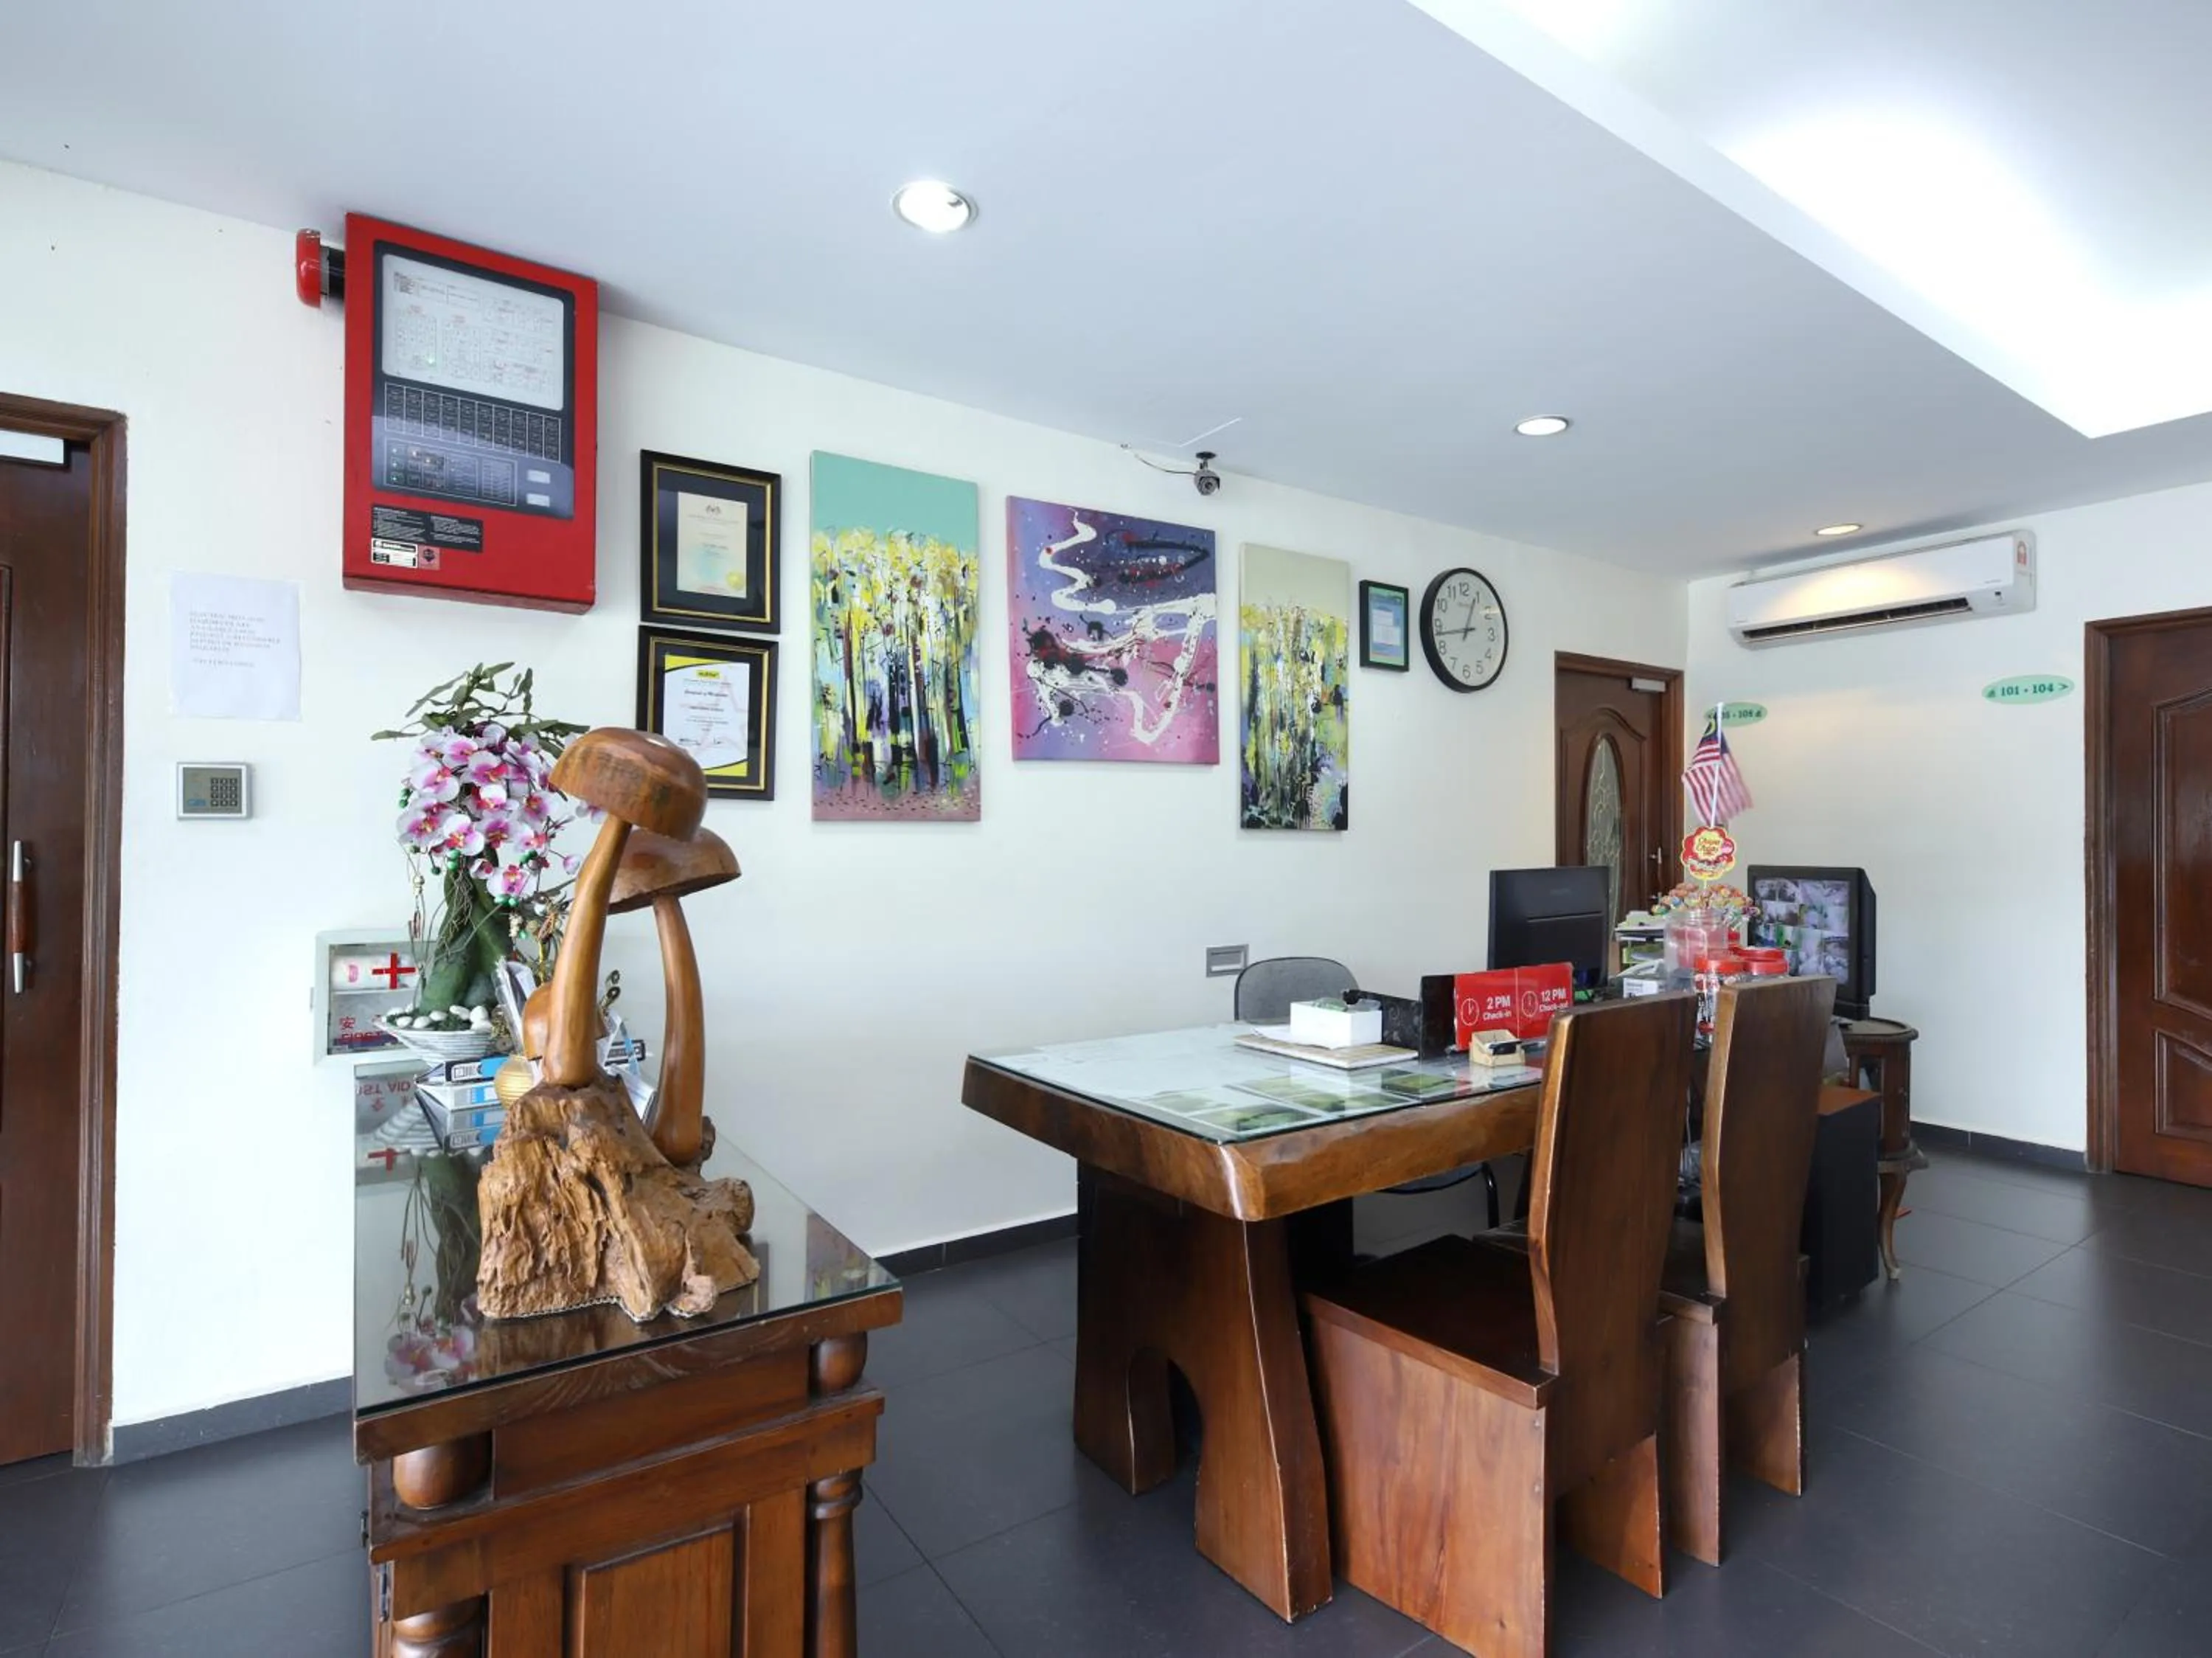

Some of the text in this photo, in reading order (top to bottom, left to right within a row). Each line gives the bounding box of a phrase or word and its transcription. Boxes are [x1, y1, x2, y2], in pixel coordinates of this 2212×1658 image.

[1447, 585, 1456, 600] 11
[1459, 582, 1470, 596] 12
[1436, 598, 1447, 613] 10
[1484, 606, 1492, 620] 2
[1434, 618, 1443, 634] 9
[1488, 628, 1495, 642] 3
[1439, 640, 1447, 655] 8
[1485, 648, 1492, 660] 4
[1450, 656, 1458, 670] 7
[1475, 660, 1484, 674] 5
[1463, 665, 1470, 679] 6
[2001, 685, 2020, 696] 101
[2032, 683, 2053, 693] 104
[1541, 988, 1567, 1002] 12 PM
[1486, 996, 1510, 1010] 2 PM
[1483, 1010, 1511, 1021] Check-in
